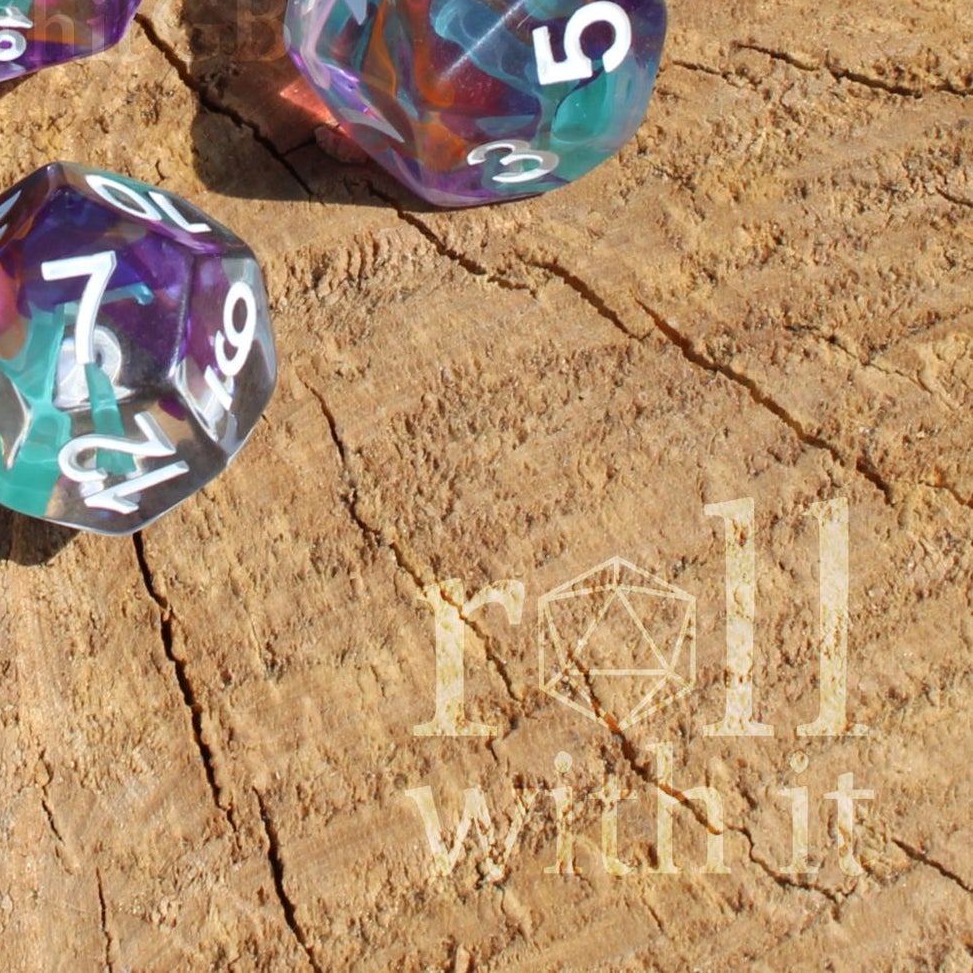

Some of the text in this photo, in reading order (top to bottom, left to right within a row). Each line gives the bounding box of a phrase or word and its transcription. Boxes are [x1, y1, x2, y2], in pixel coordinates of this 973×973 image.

[532, 1, 632, 85] 5
[467, 140, 559, 183] 3
[41, 251, 117, 365] 7
